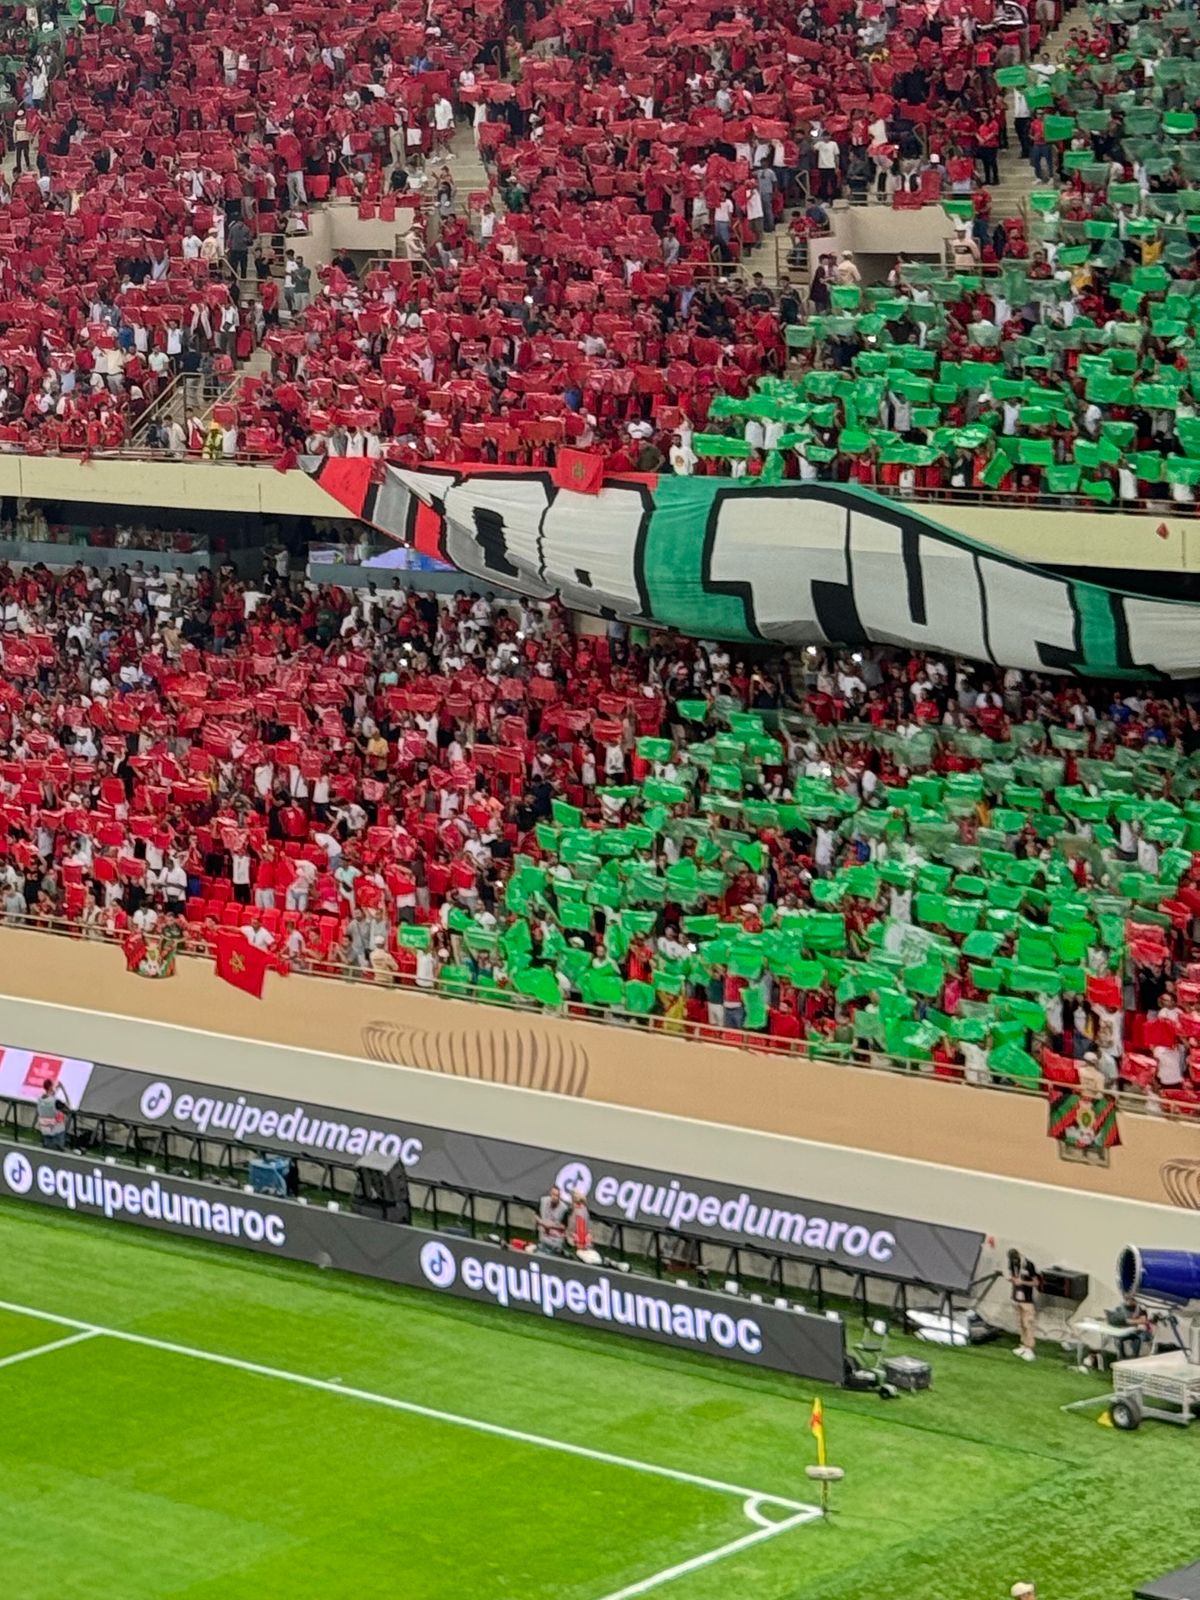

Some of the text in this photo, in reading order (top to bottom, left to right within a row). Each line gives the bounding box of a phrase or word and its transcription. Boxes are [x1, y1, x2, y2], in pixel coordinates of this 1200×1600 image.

[173, 1090, 423, 1167] equipedumaroc
[37, 1164, 286, 1247] equipedumaroc
[595, 1174, 896, 1262] equipedumaroc
[461, 1254, 763, 1355] equipedumaroc
